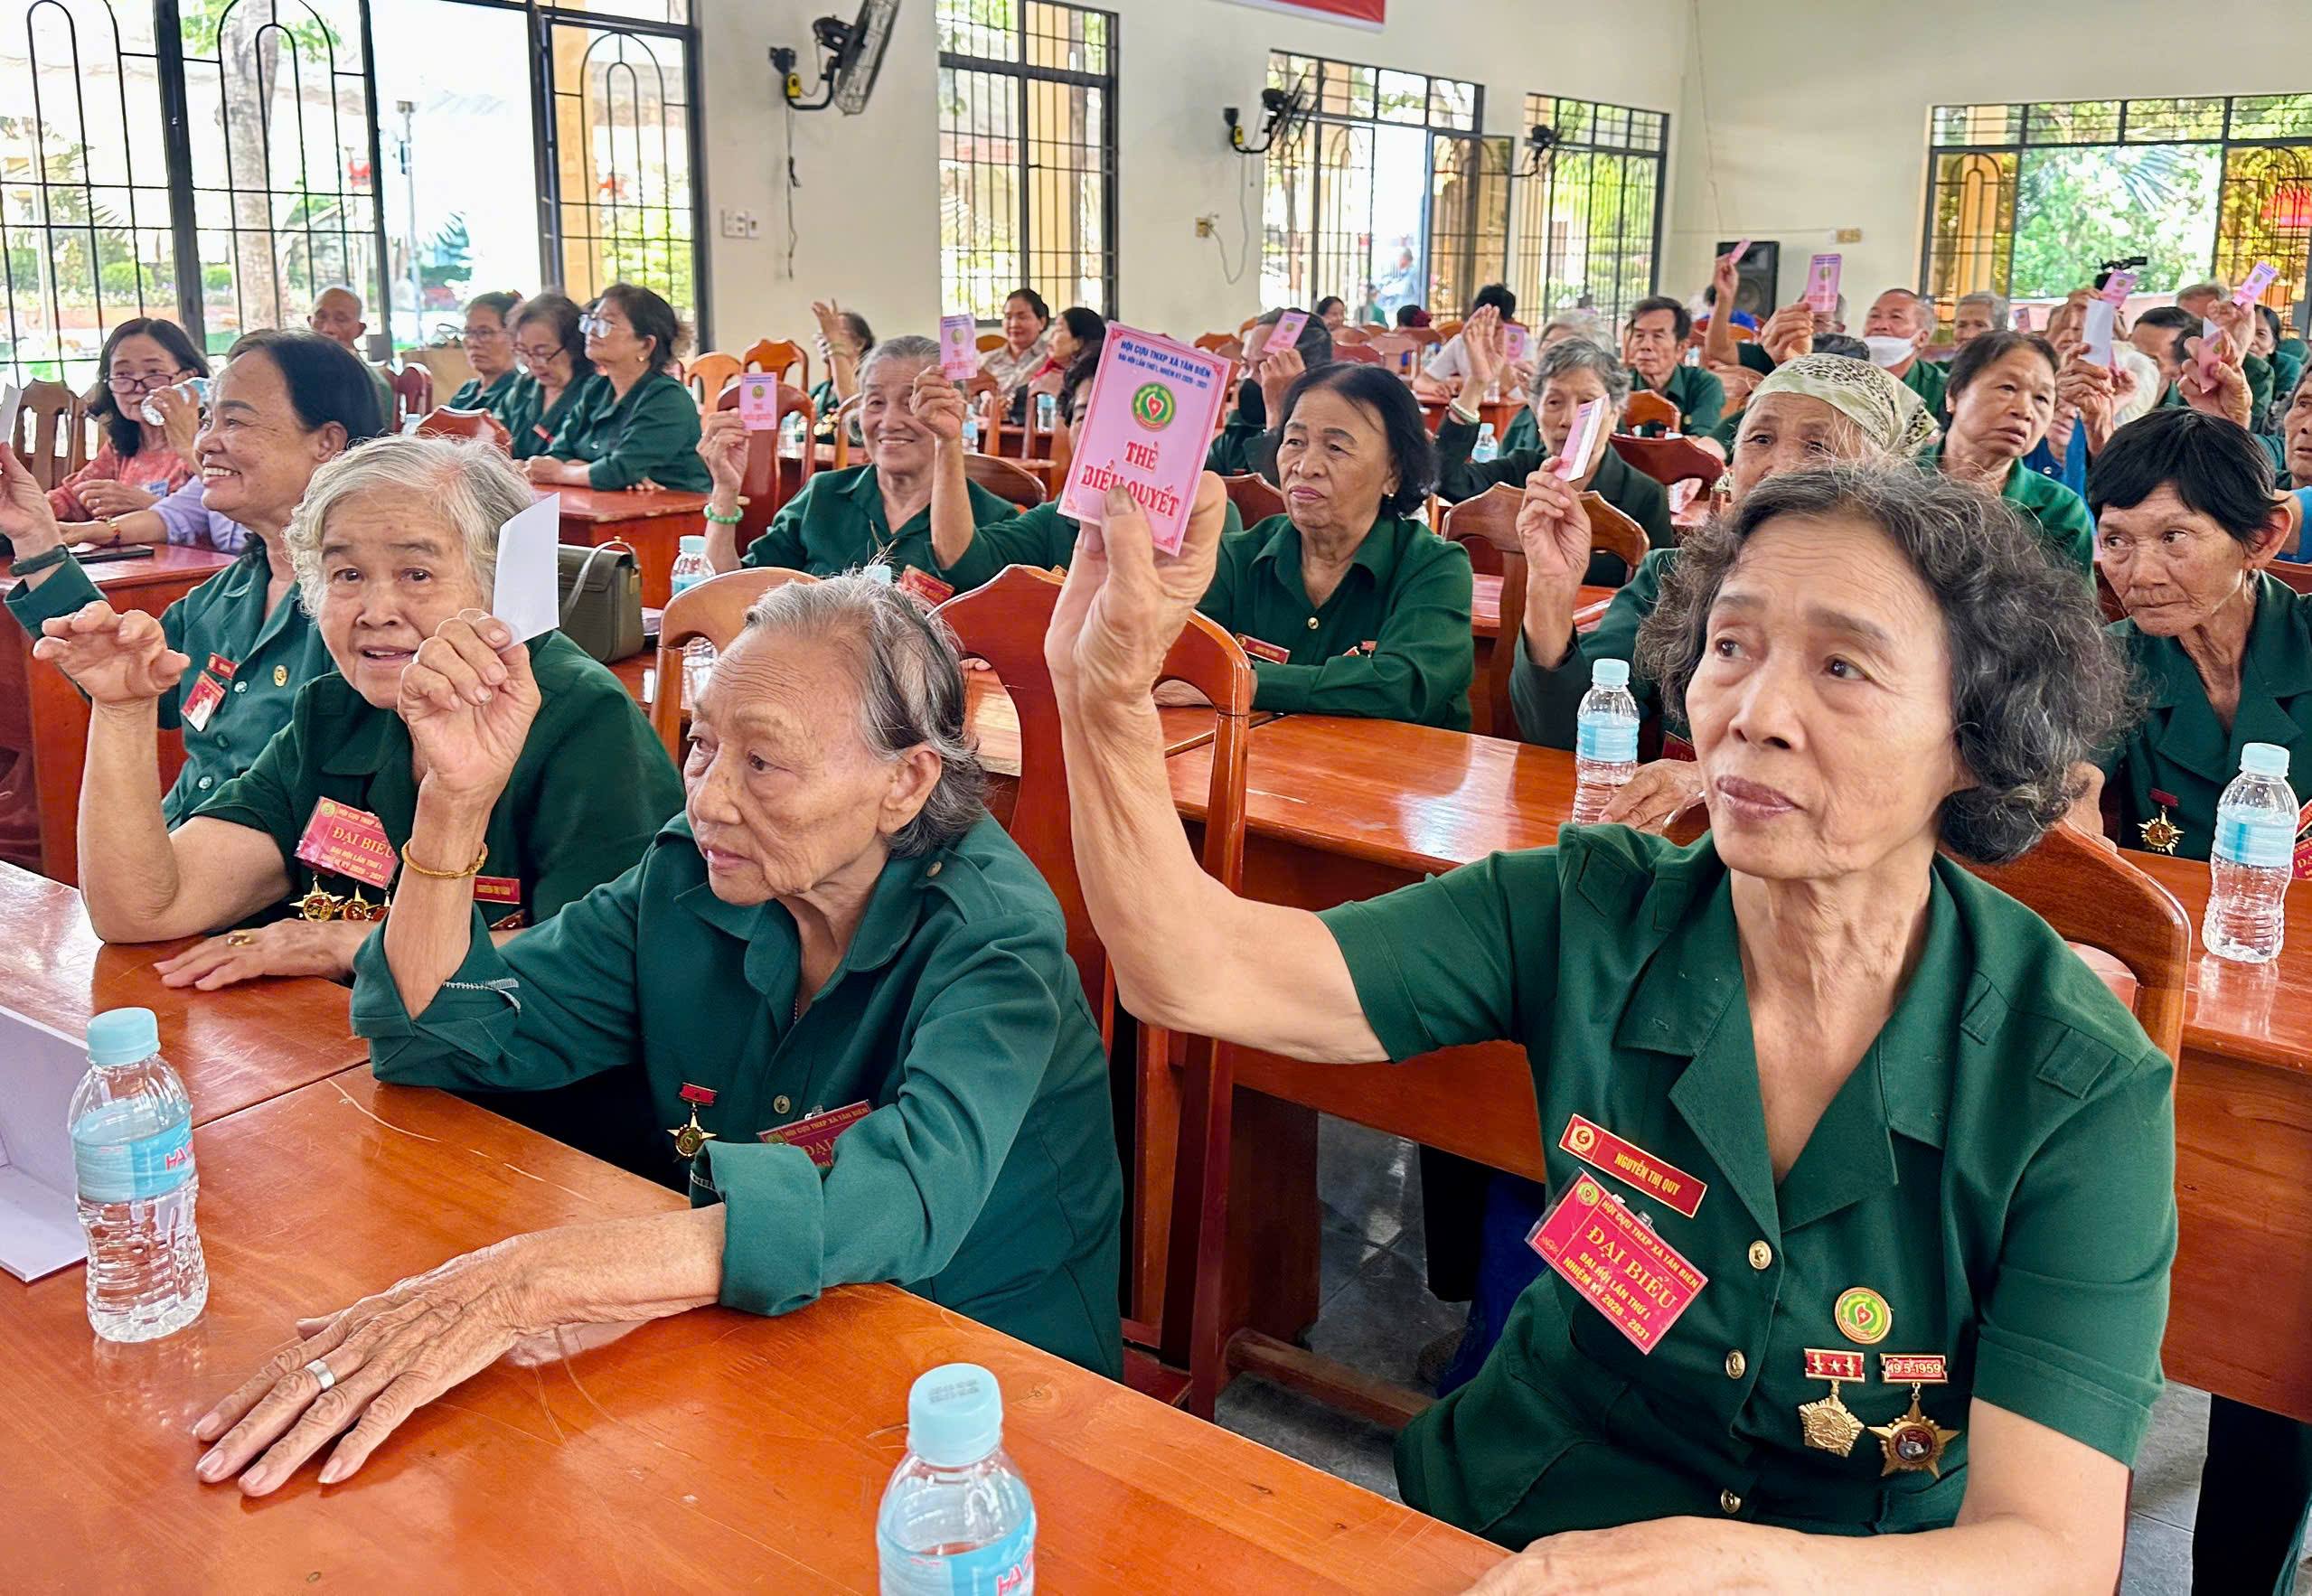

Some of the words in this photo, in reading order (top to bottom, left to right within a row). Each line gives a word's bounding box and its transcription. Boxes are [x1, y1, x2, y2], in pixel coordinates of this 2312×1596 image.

[1125, 441, 1159, 471] THẺ
[332, 826, 361, 846] ĐẠI
[1647, 1169, 1663, 1189] THỊ
[1631, 1225, 1653, 1246] TNXP
[1585, 1224, 1628, 1265] ĐẠI
[1623, 1258, 1678, 1309] BIỂU
[1627, 1318, 1650, 1341] 2031
